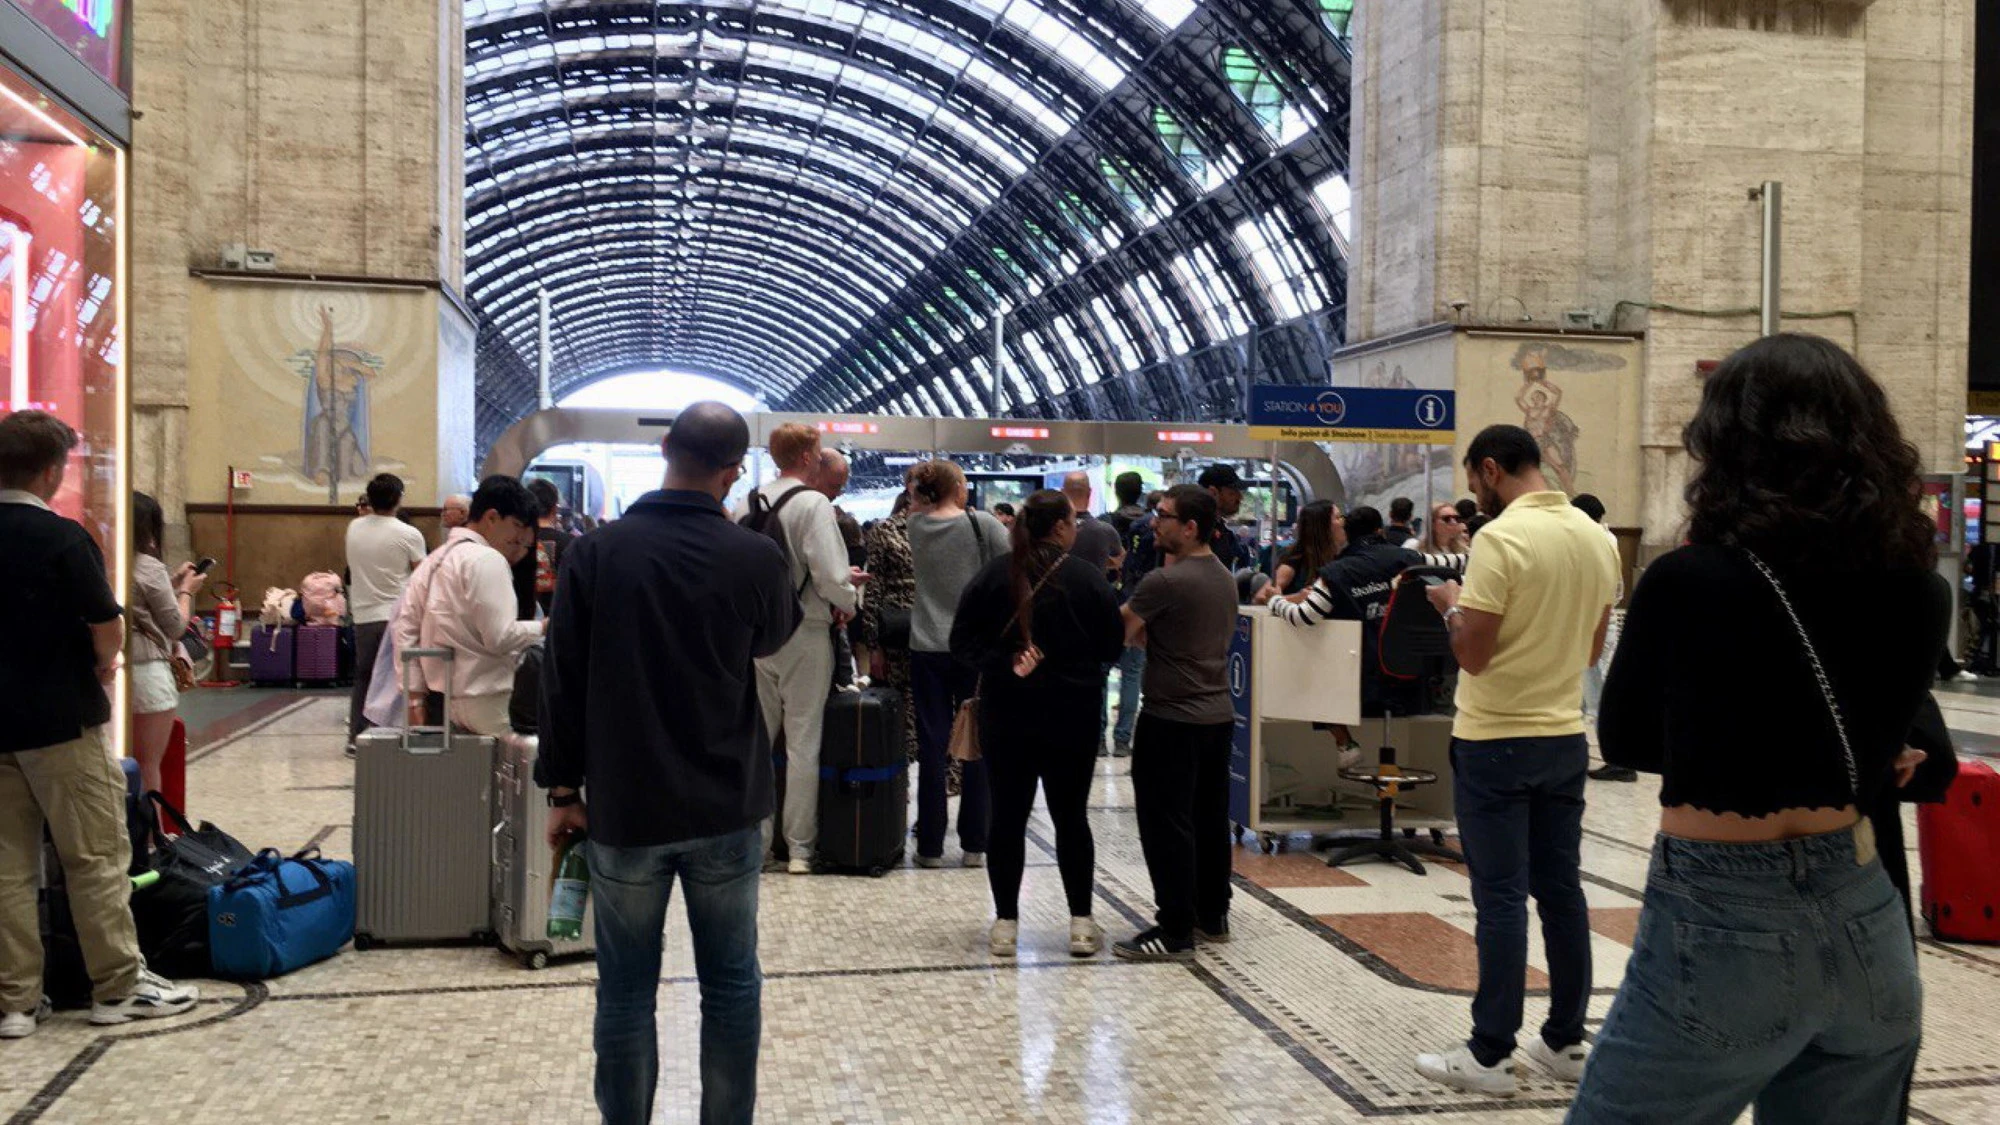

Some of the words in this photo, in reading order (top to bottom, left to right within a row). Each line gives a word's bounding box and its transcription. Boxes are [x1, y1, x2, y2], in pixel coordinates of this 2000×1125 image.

[1263, 400, 1308, 413] STATION
[1318, 402, 1342, 414] YOU
[1351, 581, 1390, 598] Station
